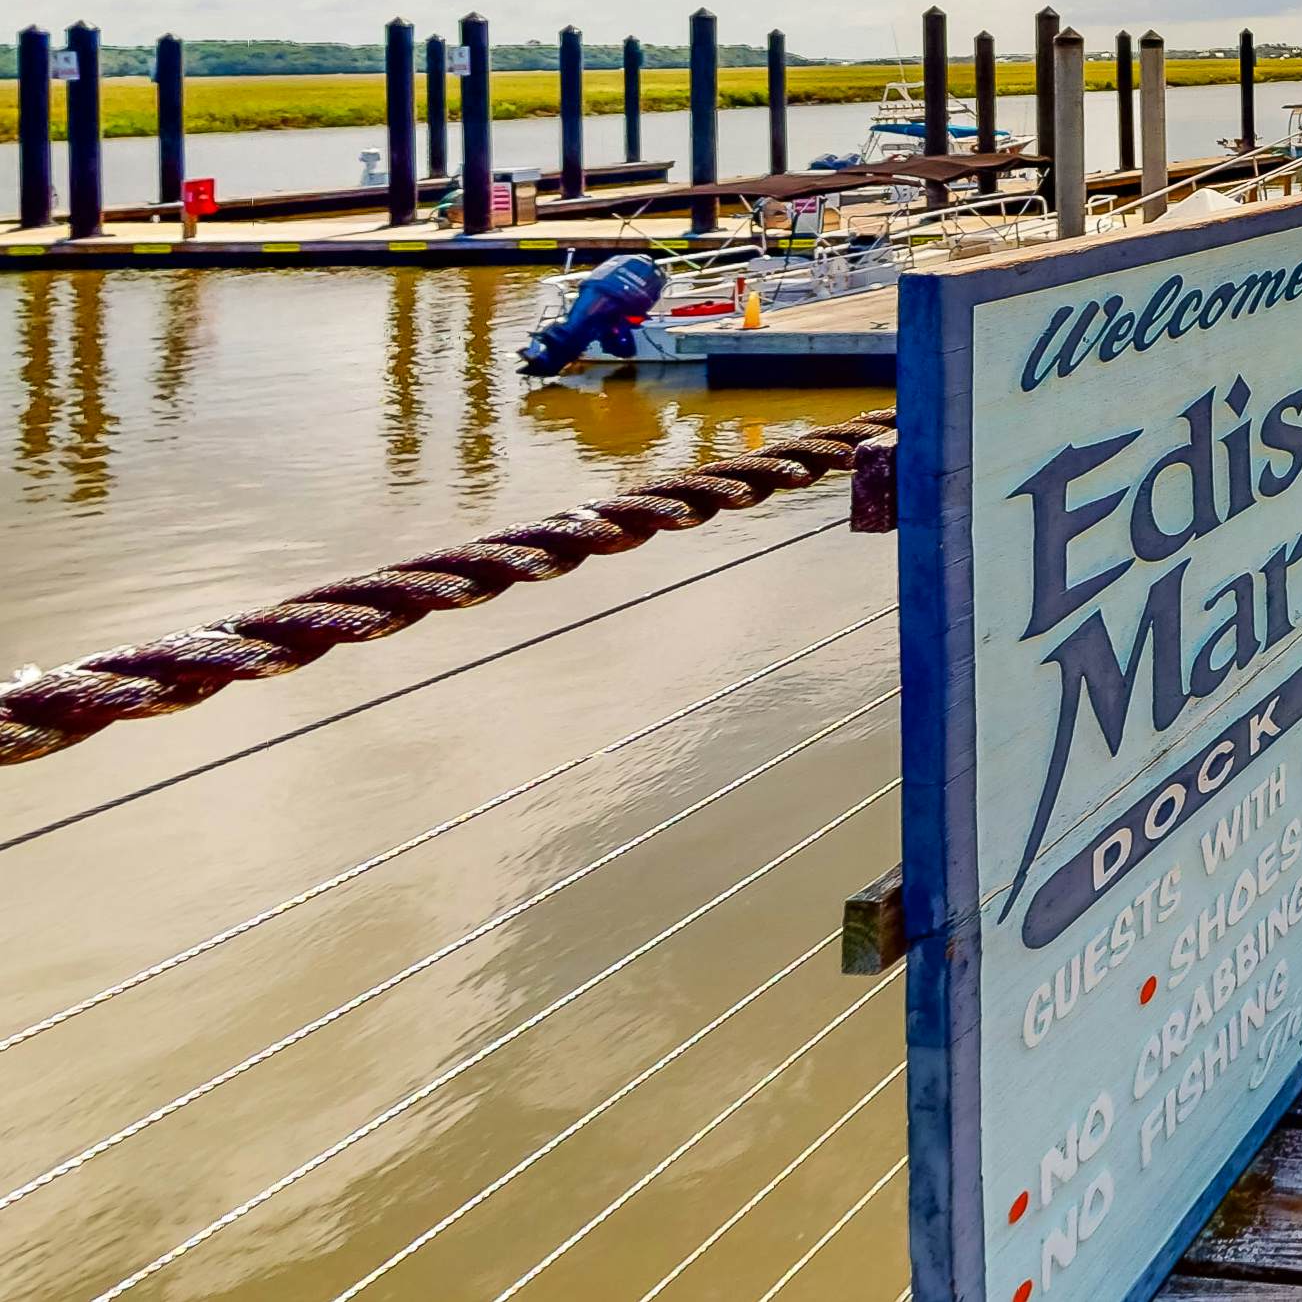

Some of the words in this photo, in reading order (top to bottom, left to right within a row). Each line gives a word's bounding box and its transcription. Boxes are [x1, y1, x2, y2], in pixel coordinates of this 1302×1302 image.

[1092, 696, 1281, 894] DOCK
[1022, 864, 1182, 1049] GUESTS
[1201, 763, 1288, 876] WITH
[1167, 818, 1302, 989] SHOES
[1040, 1094, 1114, 1206] NO
[1041, 1168, 1114, 1293] NO
[1139, 959, 1291, 1171] FISHING
